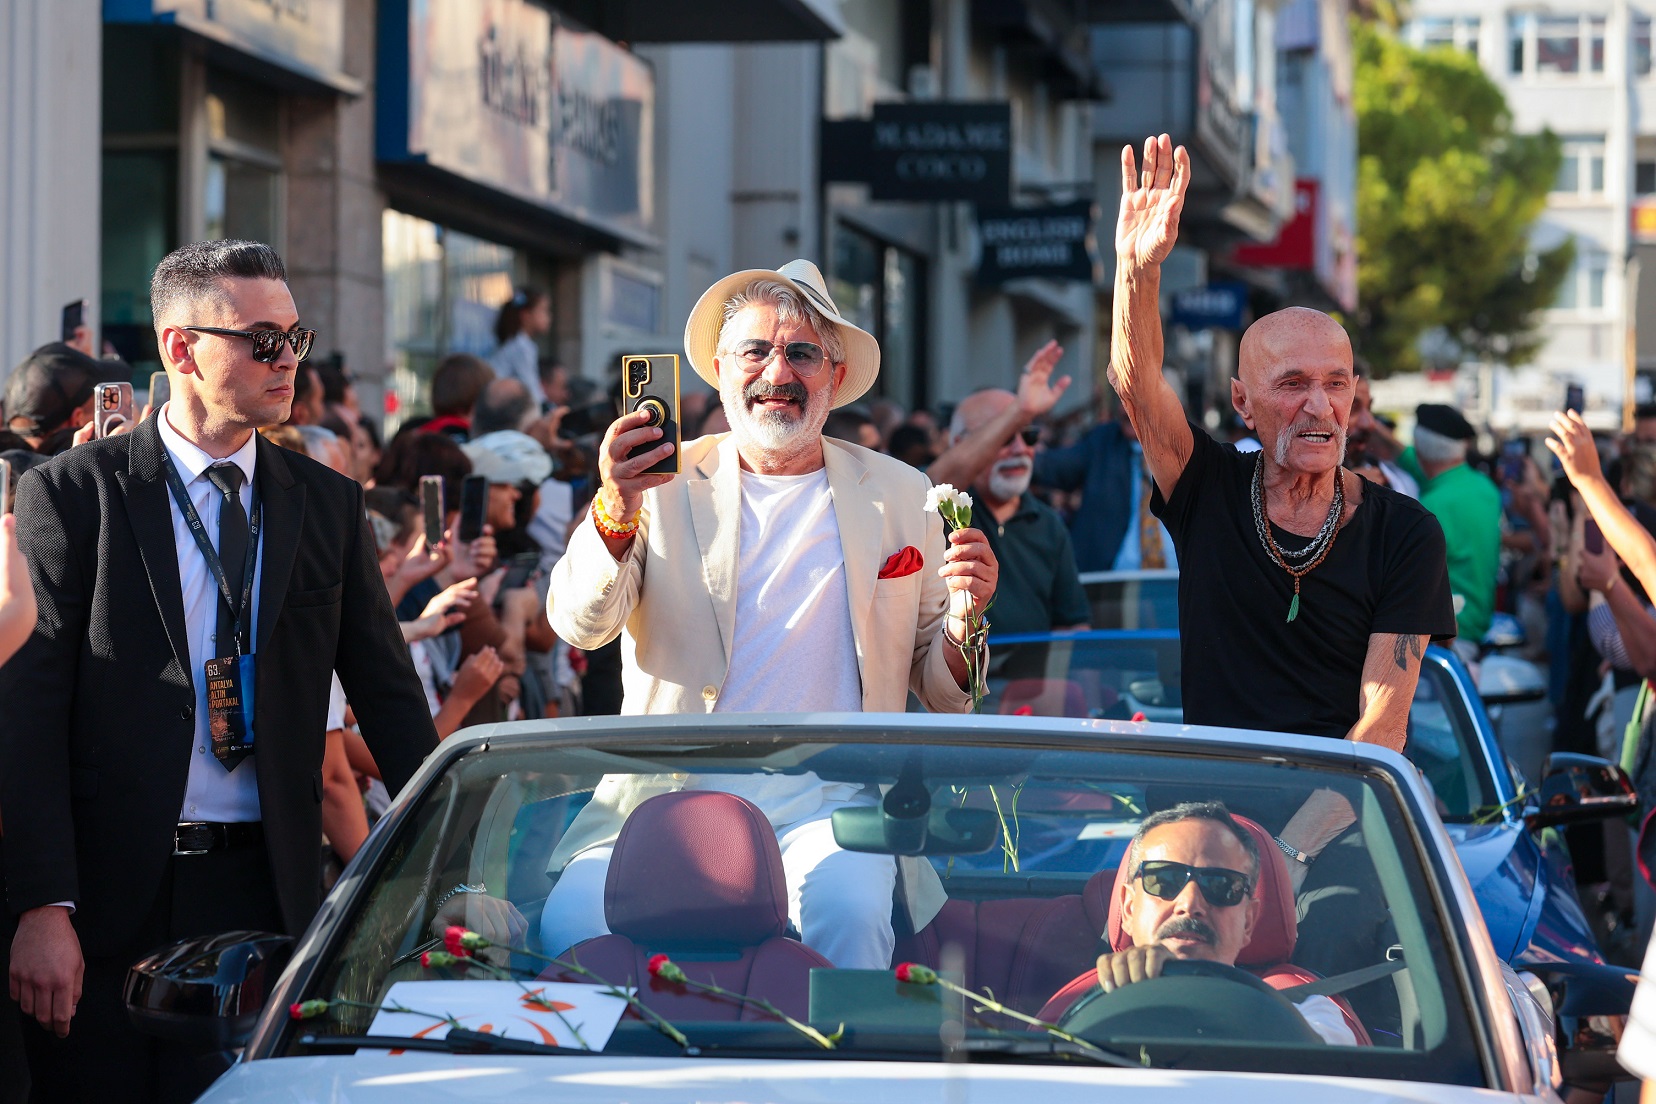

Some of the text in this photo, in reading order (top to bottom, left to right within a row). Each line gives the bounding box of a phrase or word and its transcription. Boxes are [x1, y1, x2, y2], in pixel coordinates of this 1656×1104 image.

[874, 122, 1007, 151] MADAME
[896, 153, 987, 181] COCO
[207, 664, 221, 677] 63.
[210, 679, 234, 690] ANTALYA
[211, 689, 226, 700] ALTIN
[211, 697, 239, 709] PORTAKAL
